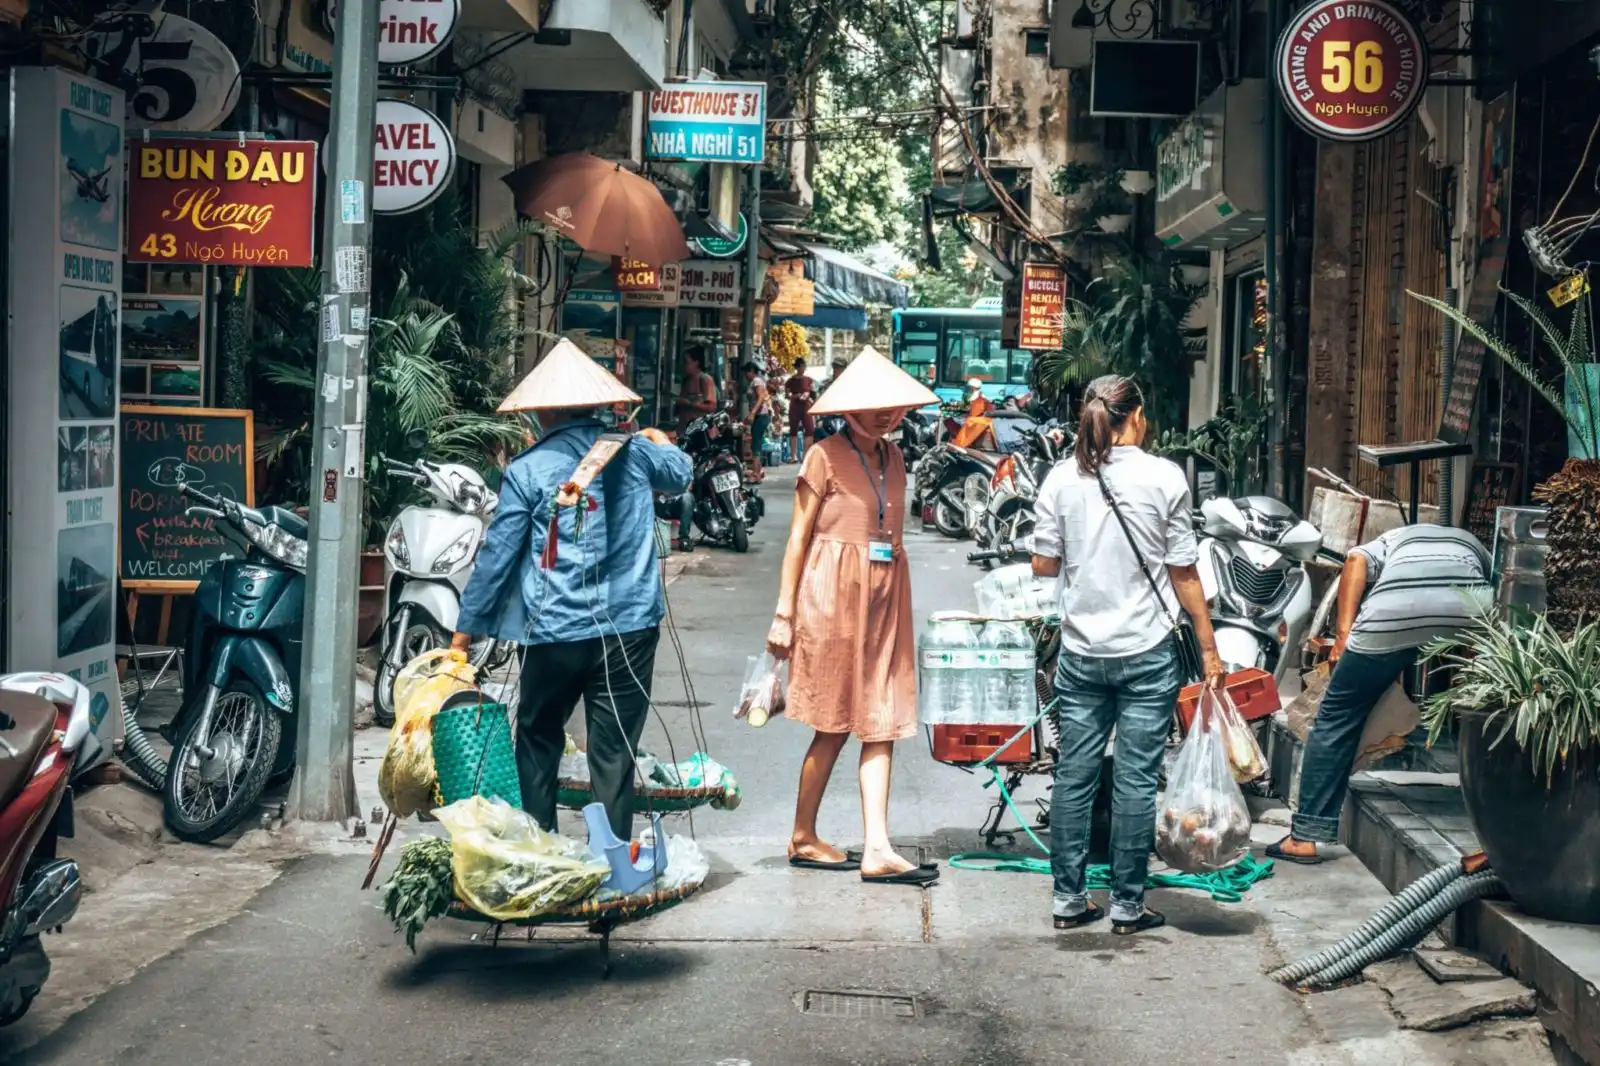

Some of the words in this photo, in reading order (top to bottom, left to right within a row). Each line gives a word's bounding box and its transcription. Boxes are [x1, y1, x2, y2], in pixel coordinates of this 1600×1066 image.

[378, 15, 438, 44] rink
[1301, 12, 1331, 42] AND
[1334, 5, 1407, 45] DRINKING
[1292, 45, 1314, 102] EATING
[1321, 40, 1384, 94] 56
[1390, 49, 1415, 102] HOUSE
[651, 90, 738, 116] GUESTHOUSE
[741, 93, 758, 117] 51
[375, 123, 436, 150] AVEL
[651, 127, 686, 154] NHÀ
[692, 126, 734, 156] NGHỈ
[737, 136, 757, 157] 51
[374, 159, 439, 187] ENCY
[140, 233, 177, 257] 43
[185, 241, 225, 262] Ngõ
[232, 242, 289, 264] Huyện
[1029, 280, 1060, 291] BICYCLE
[1031, 294, 1062, 304] RENTAL
[1030, 306, 1047, 315] BUY
[125, 418, 206, 442] PRIVATE
[187, 443, 242, 465] ROOM
